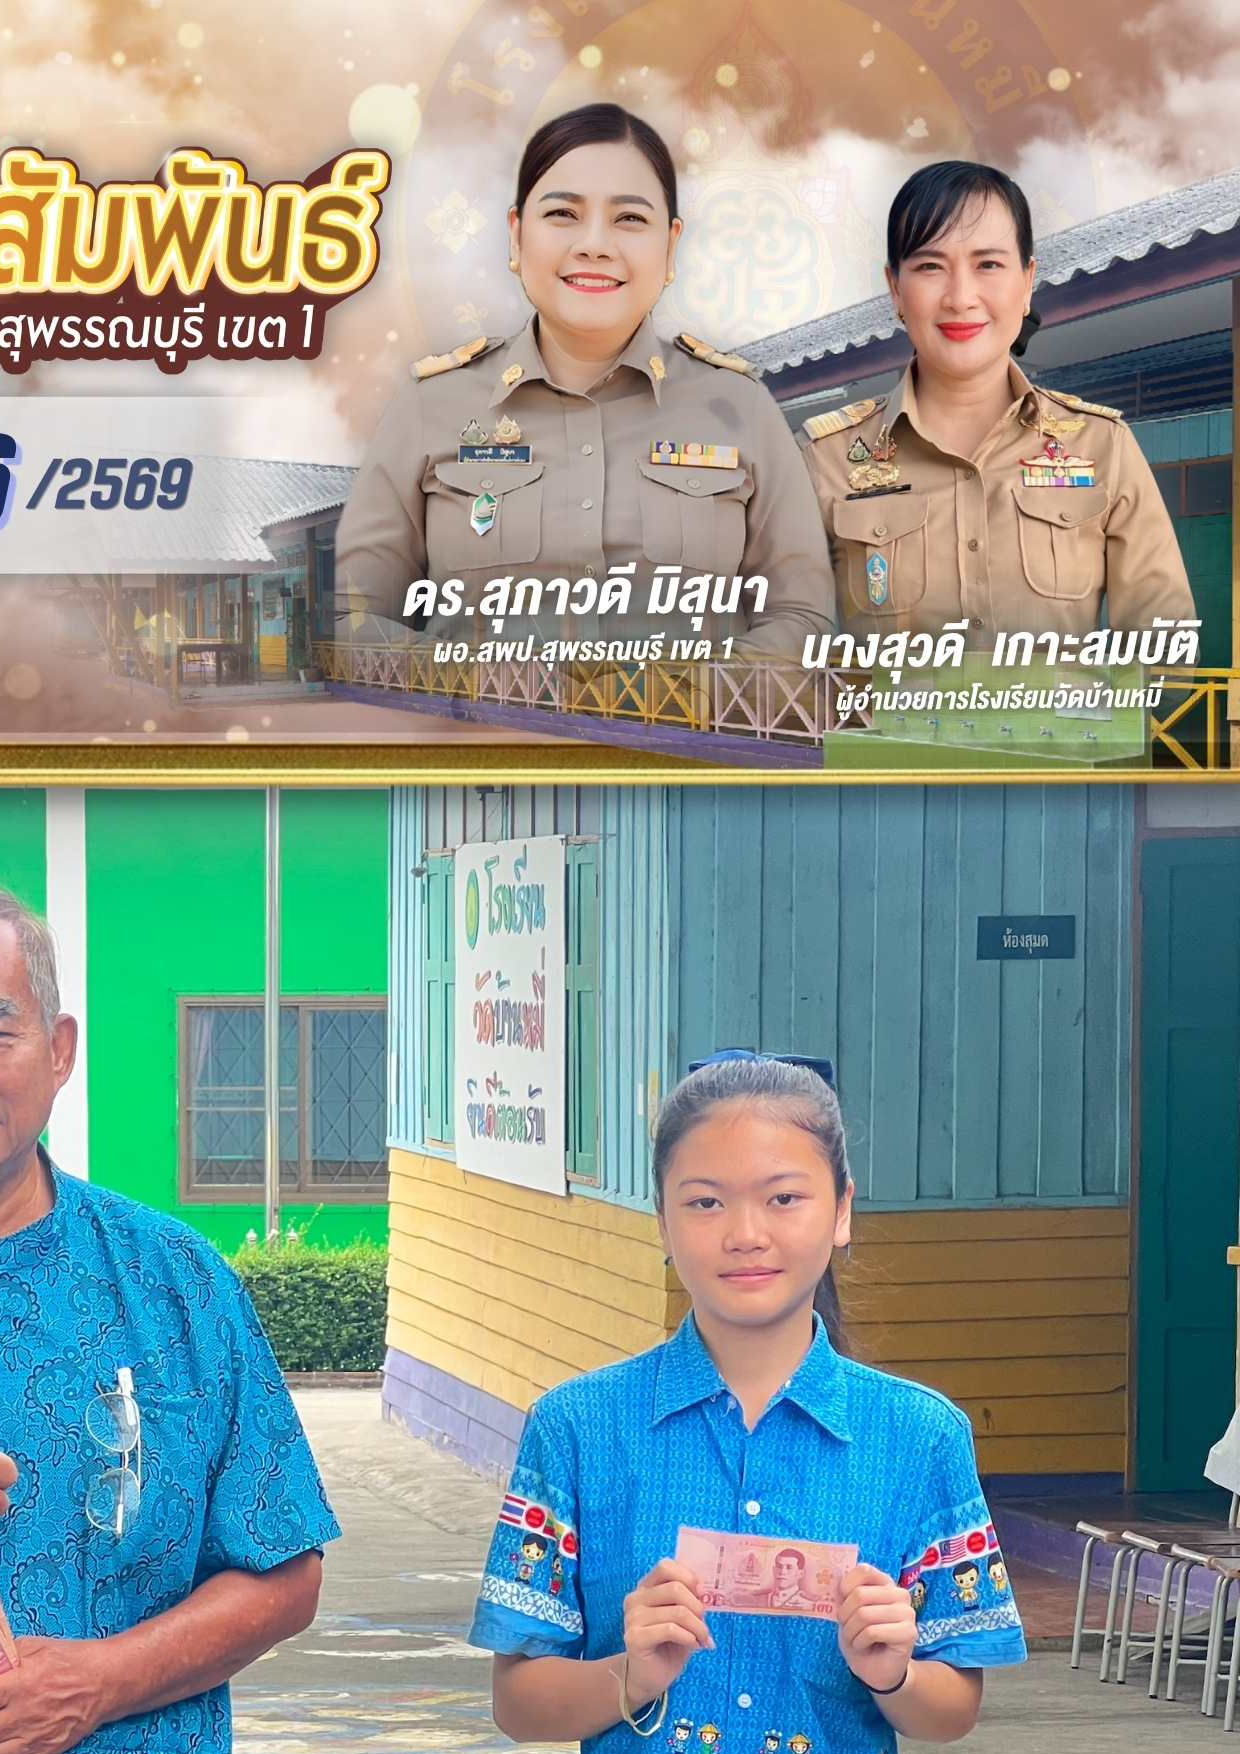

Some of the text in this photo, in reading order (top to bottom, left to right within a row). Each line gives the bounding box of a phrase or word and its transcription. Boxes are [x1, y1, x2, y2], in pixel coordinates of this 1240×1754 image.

[484, 844, 546, 936] โรงเรียน
[473, 946, 546, 1053] วัดบ้านหมี่
[466, 1070, 546, 1145] ยินดีต้อนรับ
